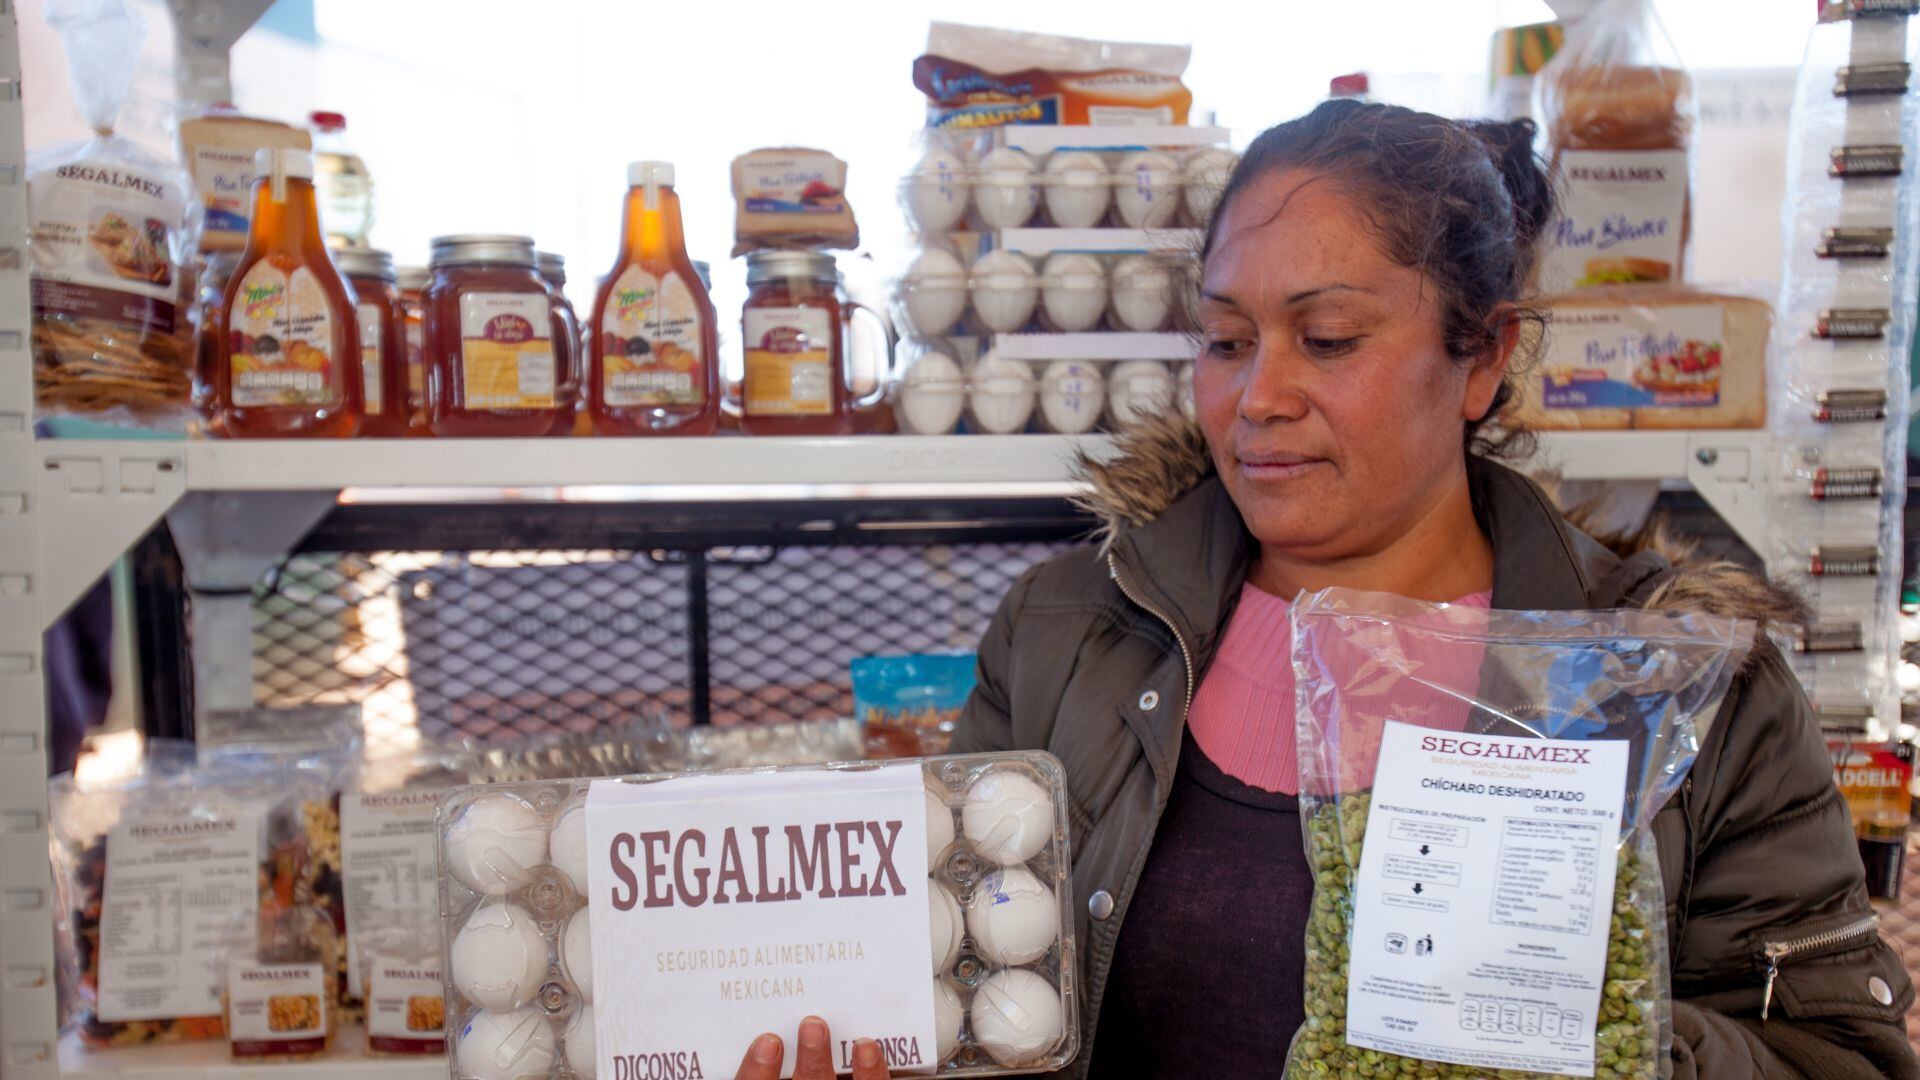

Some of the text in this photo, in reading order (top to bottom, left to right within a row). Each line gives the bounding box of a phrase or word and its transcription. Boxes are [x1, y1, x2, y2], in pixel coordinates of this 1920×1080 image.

[56, 164, 164, 199] SEGALMEX
[1569, 166, 1667, 181] SEGALMEX
[1421, 736, 1592, 764] SEGALMEX
[1430, 755, 1577, 775] SEGURIDAD ALIMENTARIA
[1471, 769, 1533, 781] MEXICANA
[1421, 776, 1585, 802] CHÍCHARO DESHIDRATADO
[609, 820, 906, 912] SEGALMEX
[657, 941, 865, 973] SEGURIDAD ALIMENTARIA
[241, 969, 312, 981] SEGALMEX
[720, 976, 806, 1001] MEXICANA
[613, 1051, 704, 1080] DICONSA
[840, 1036, 923, 1069] LONSA
